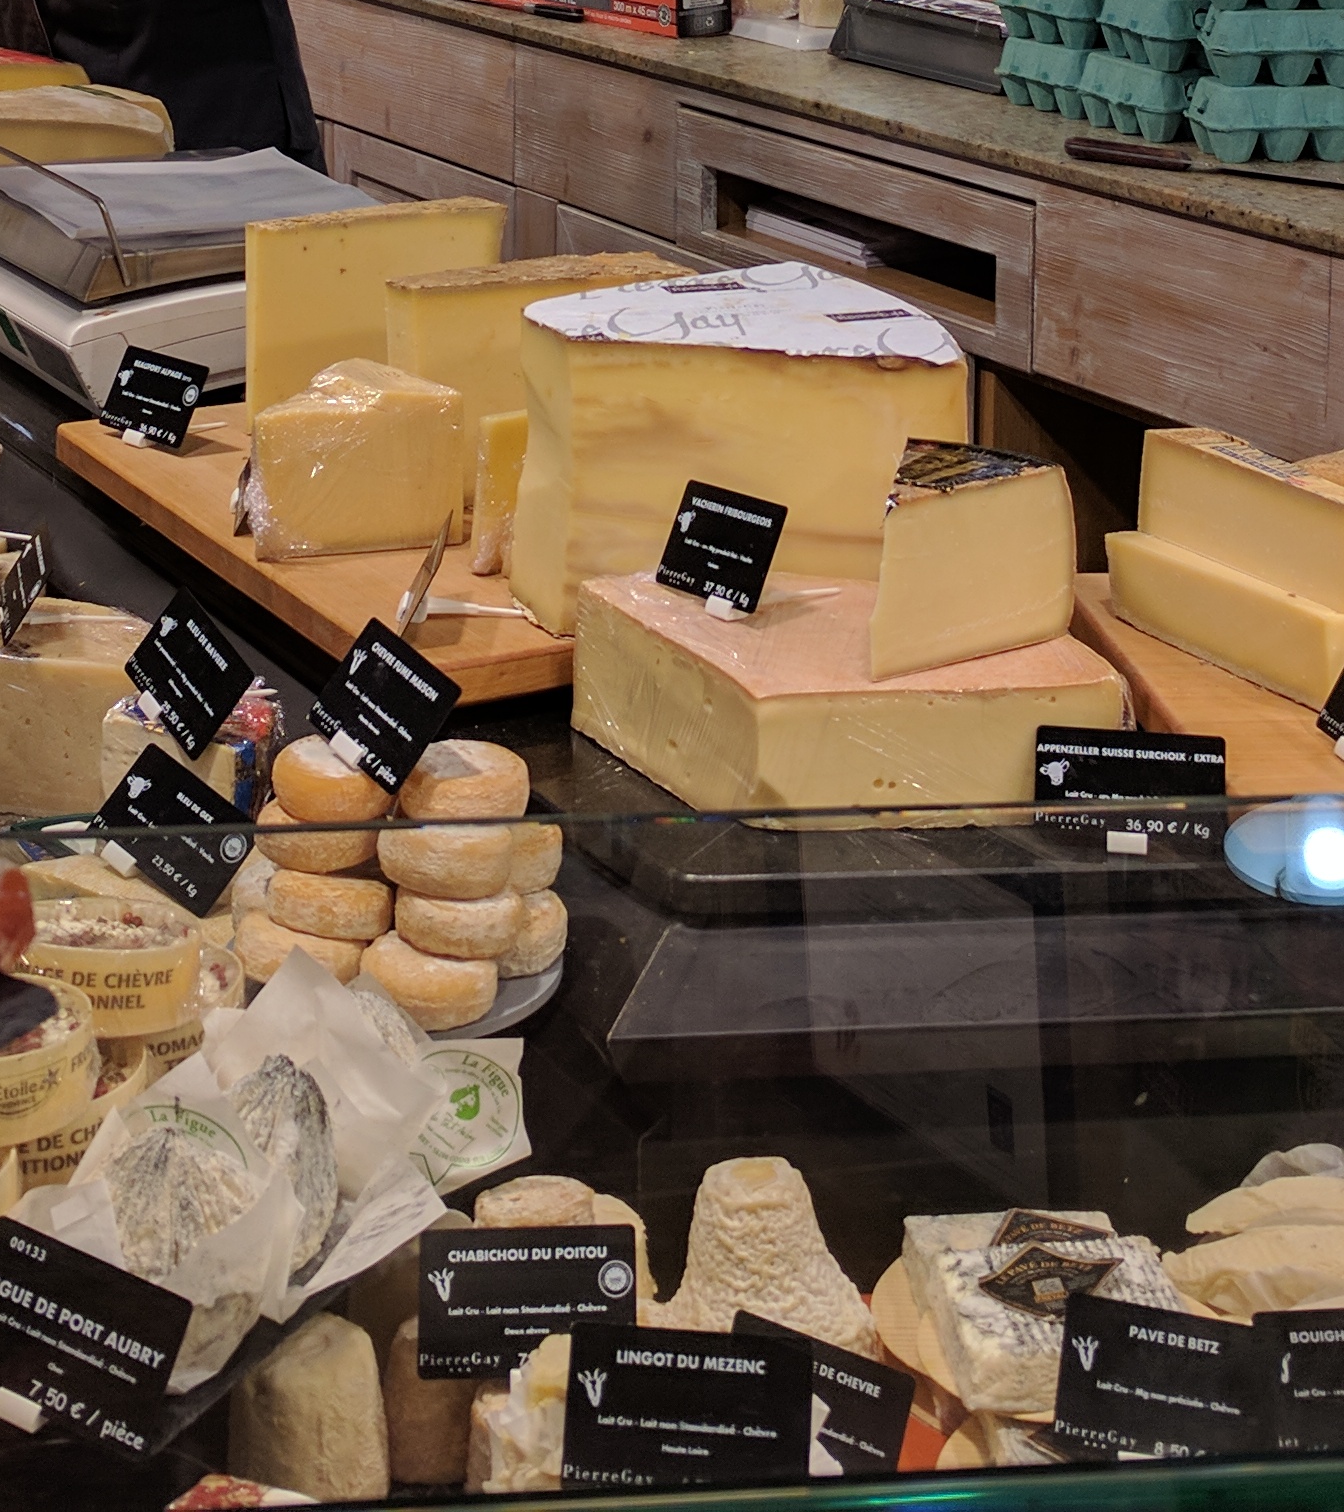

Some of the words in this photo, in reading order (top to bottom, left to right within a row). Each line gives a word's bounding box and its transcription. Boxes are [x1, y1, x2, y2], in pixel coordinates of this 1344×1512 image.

[613, 1, 625, 12] 300
[638, 5, 646, 16] 45
[647, 8, 657, 17] cm
[607, 307, 747, 339] Gay
[692, 497, 724, 513] VACHERIN
[724, 506, 773, 528] FRIBOURGEOIS
[658, 564, 695, 587] PierreGay
[187, 619, 201, 638] BLEU
[198, 633, 210, 647] DE
[205, 642, 229, 672] BAVIERE
[371, 642, 397, 666] CHEVRE
[392, 659, 411, 681] FUME
[409, 674, 440, 702] MAISON
[1037, 743, 1099, 756] APPENZELLER
[1101, 748, 1134, 759] SUISSE
[1136, 750, 1186, 762] SURCHOIX
[1194, 753, 1224, 764] EXTRA
[375, 765, 397, 786] pièce
[176, 791, 192, 807] BLEU
[190, 802, 201, 814] DE
[199, 809, 215, 824] GEX
[1035, 811, 1106, 828] PierreGay
[1168, 822, 1177, 834] €
[1194, 824, 1210, 839] Kg
[71, 971, 97, 988] DE
[104, 968, 174, 989] CHÈVRE
[482, 1063, 509, 1097] Figue
[149, 1109, 169, 1123] La
[173, 1112, 217, 1139] Figue
[37, 1133, 63, 1152] DE
[9, 1236, 46, 1262] 00133
[448, 1248, 528, 1263] CHABICHOU
[531, 1248, 552, 1260] DU
[556, 1246, 608, 1260] POITOU
[448, 1307, 464, 1315] Lait
[465, 1307, 479, 1315] Cru
[486, 1306, 502, 1315] Lait
[577, 1303, 607, 1312] Chèvre
[34, 1297, 58, 1320] DE
[58, 1308, 104, 1342] PORT
[104, 1331, 166, 1369] AUBRY
[1129, 1325, 1166, 1344] PAVE
[1167, 1332, 1186, 1348] DE
[1188, 1336, 1220, 1355] BETZ
[419, 1352, 501, 1367] PierreGay
[616, 1350, 674, 1368] LINGOT
[677, 1353, 700, 1369] DU
[703, 1356, 767, 1375] MEZENC
[108, 1364, 137, 1384] Chèvre
[819, 1364, 835, 1379] DE
[836, 1370, 881, 1398] CHEVRE
[70, 1402, 86, 1420] €
[99, 1419, 144, 1451] pièce
[640, 1417, 657, 1429] Lait
[743, 1425, 777, 1439] Chèvre
[1055, 1419, 1137, 1448] PierreGay
[661, 1443, 687, 1454] Haute
[687, 1445, 709, 1456] Loire
[562, 1463, 654, 1485] PierreGay
